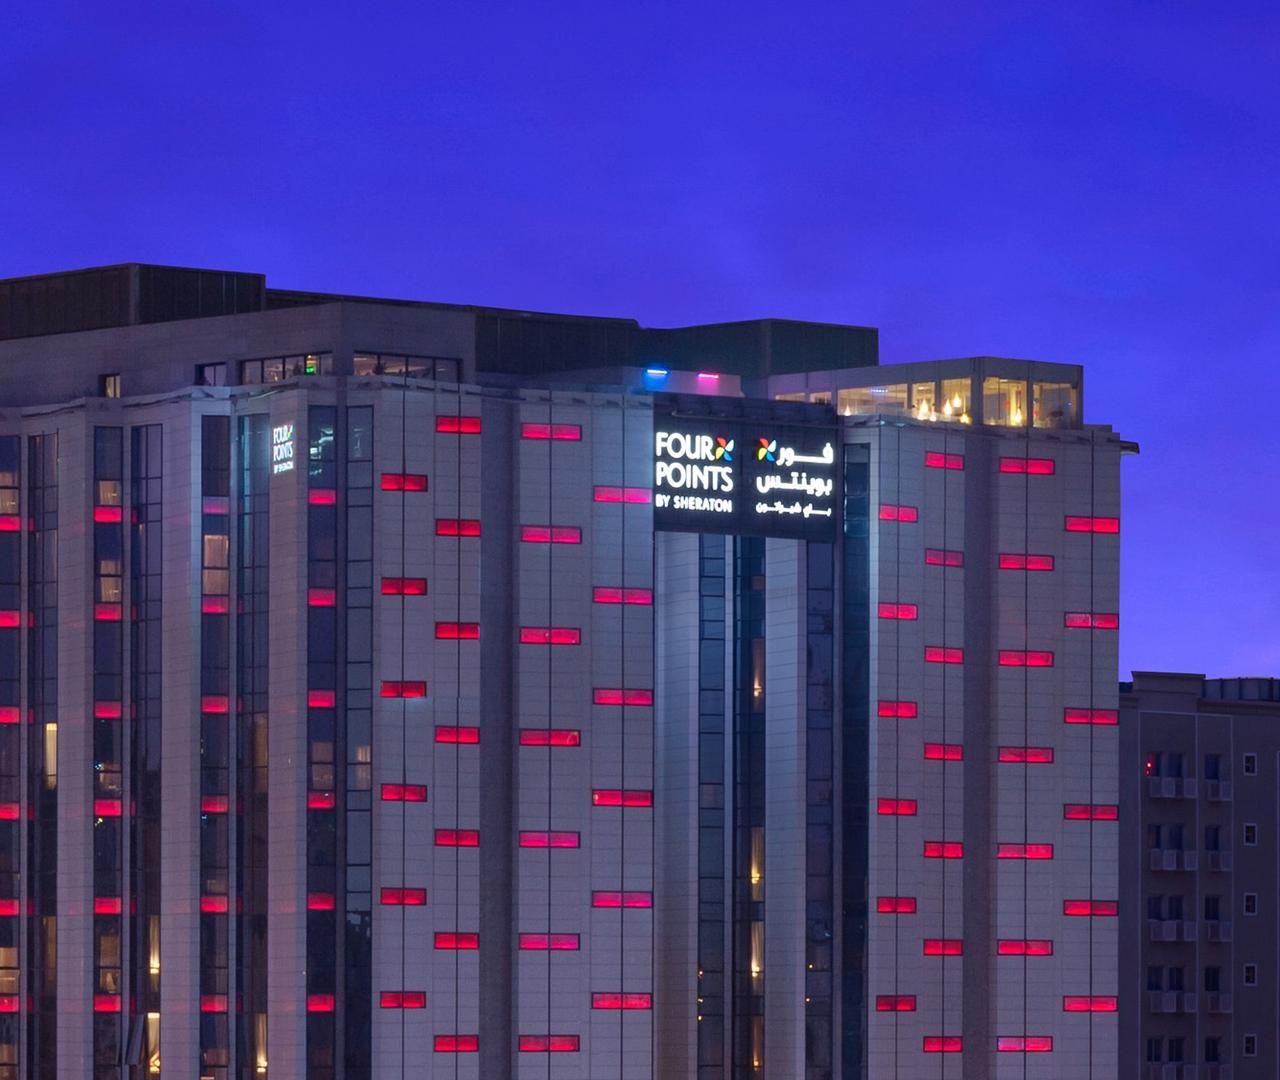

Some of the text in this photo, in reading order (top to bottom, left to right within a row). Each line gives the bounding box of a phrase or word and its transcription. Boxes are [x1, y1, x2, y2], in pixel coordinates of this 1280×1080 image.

[273, 425, 288, 444] FOUR
[655, 431, 716, 461] FOUR
[273, 441, 293, 462] POINTS
[776, 442, 834, 466] فور
[655, 461, 734, 492] POINTS
[756, 471, 833, 497] بوينتس
[655, 493, 733, 513] BY SHERATON
